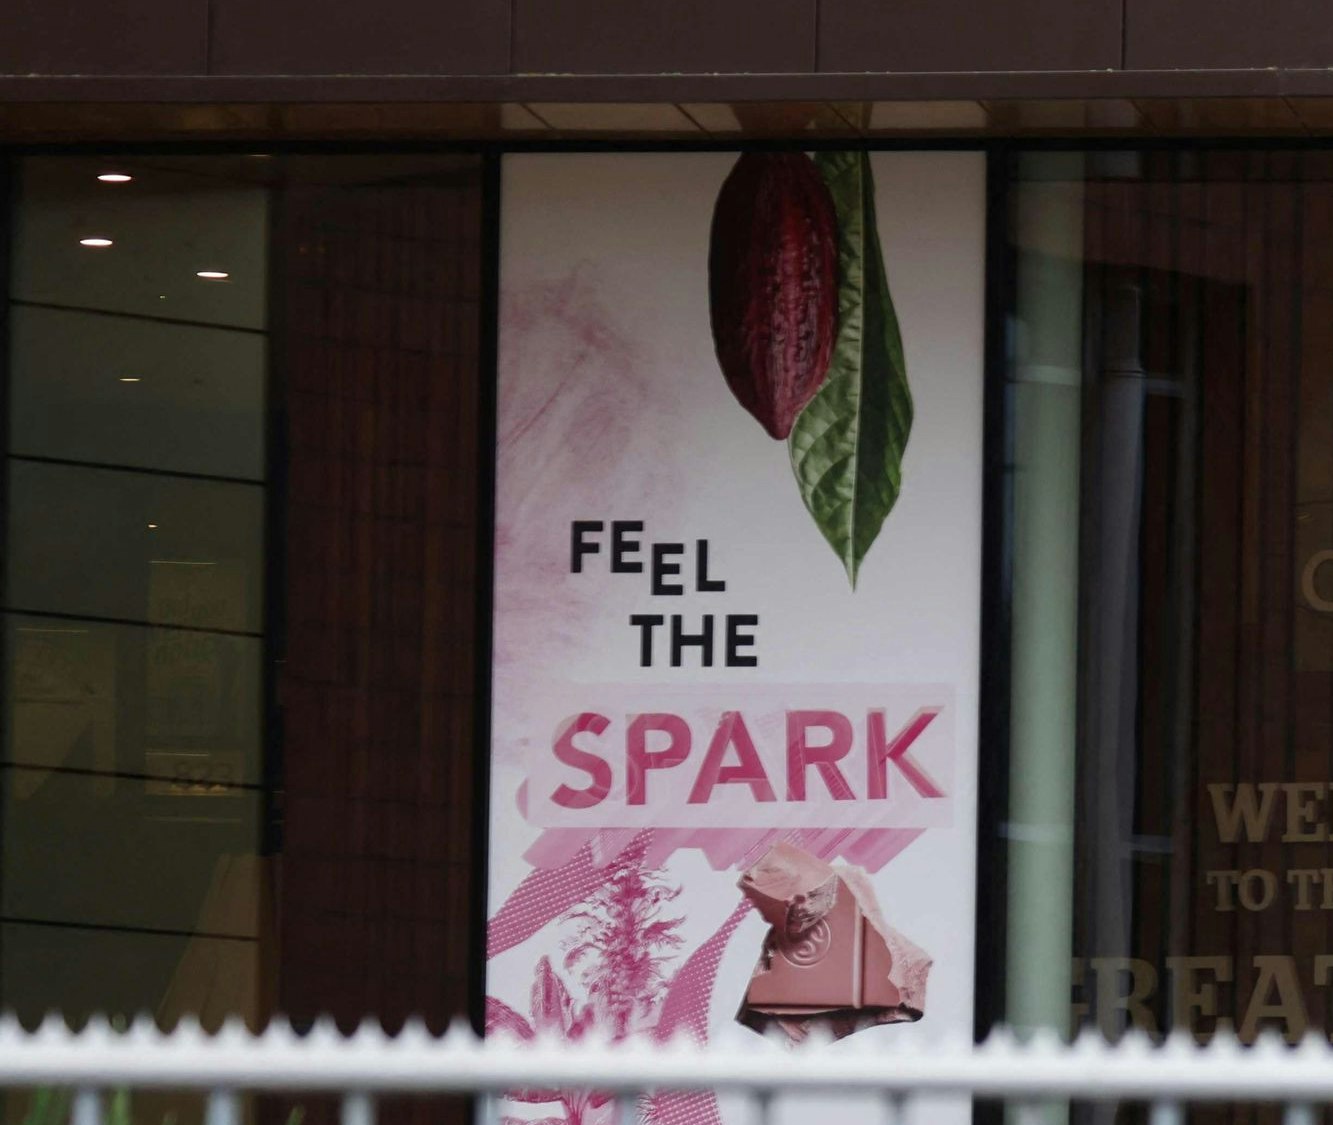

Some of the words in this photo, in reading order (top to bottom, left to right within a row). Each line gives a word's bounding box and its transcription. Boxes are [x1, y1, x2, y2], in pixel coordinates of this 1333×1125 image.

[569, 520, 727, 596] FEEL
[629, 613, 760, 668] THE
[548, 703, 949, 810] SPARK
[1207, 868, 1278, 912] TO
